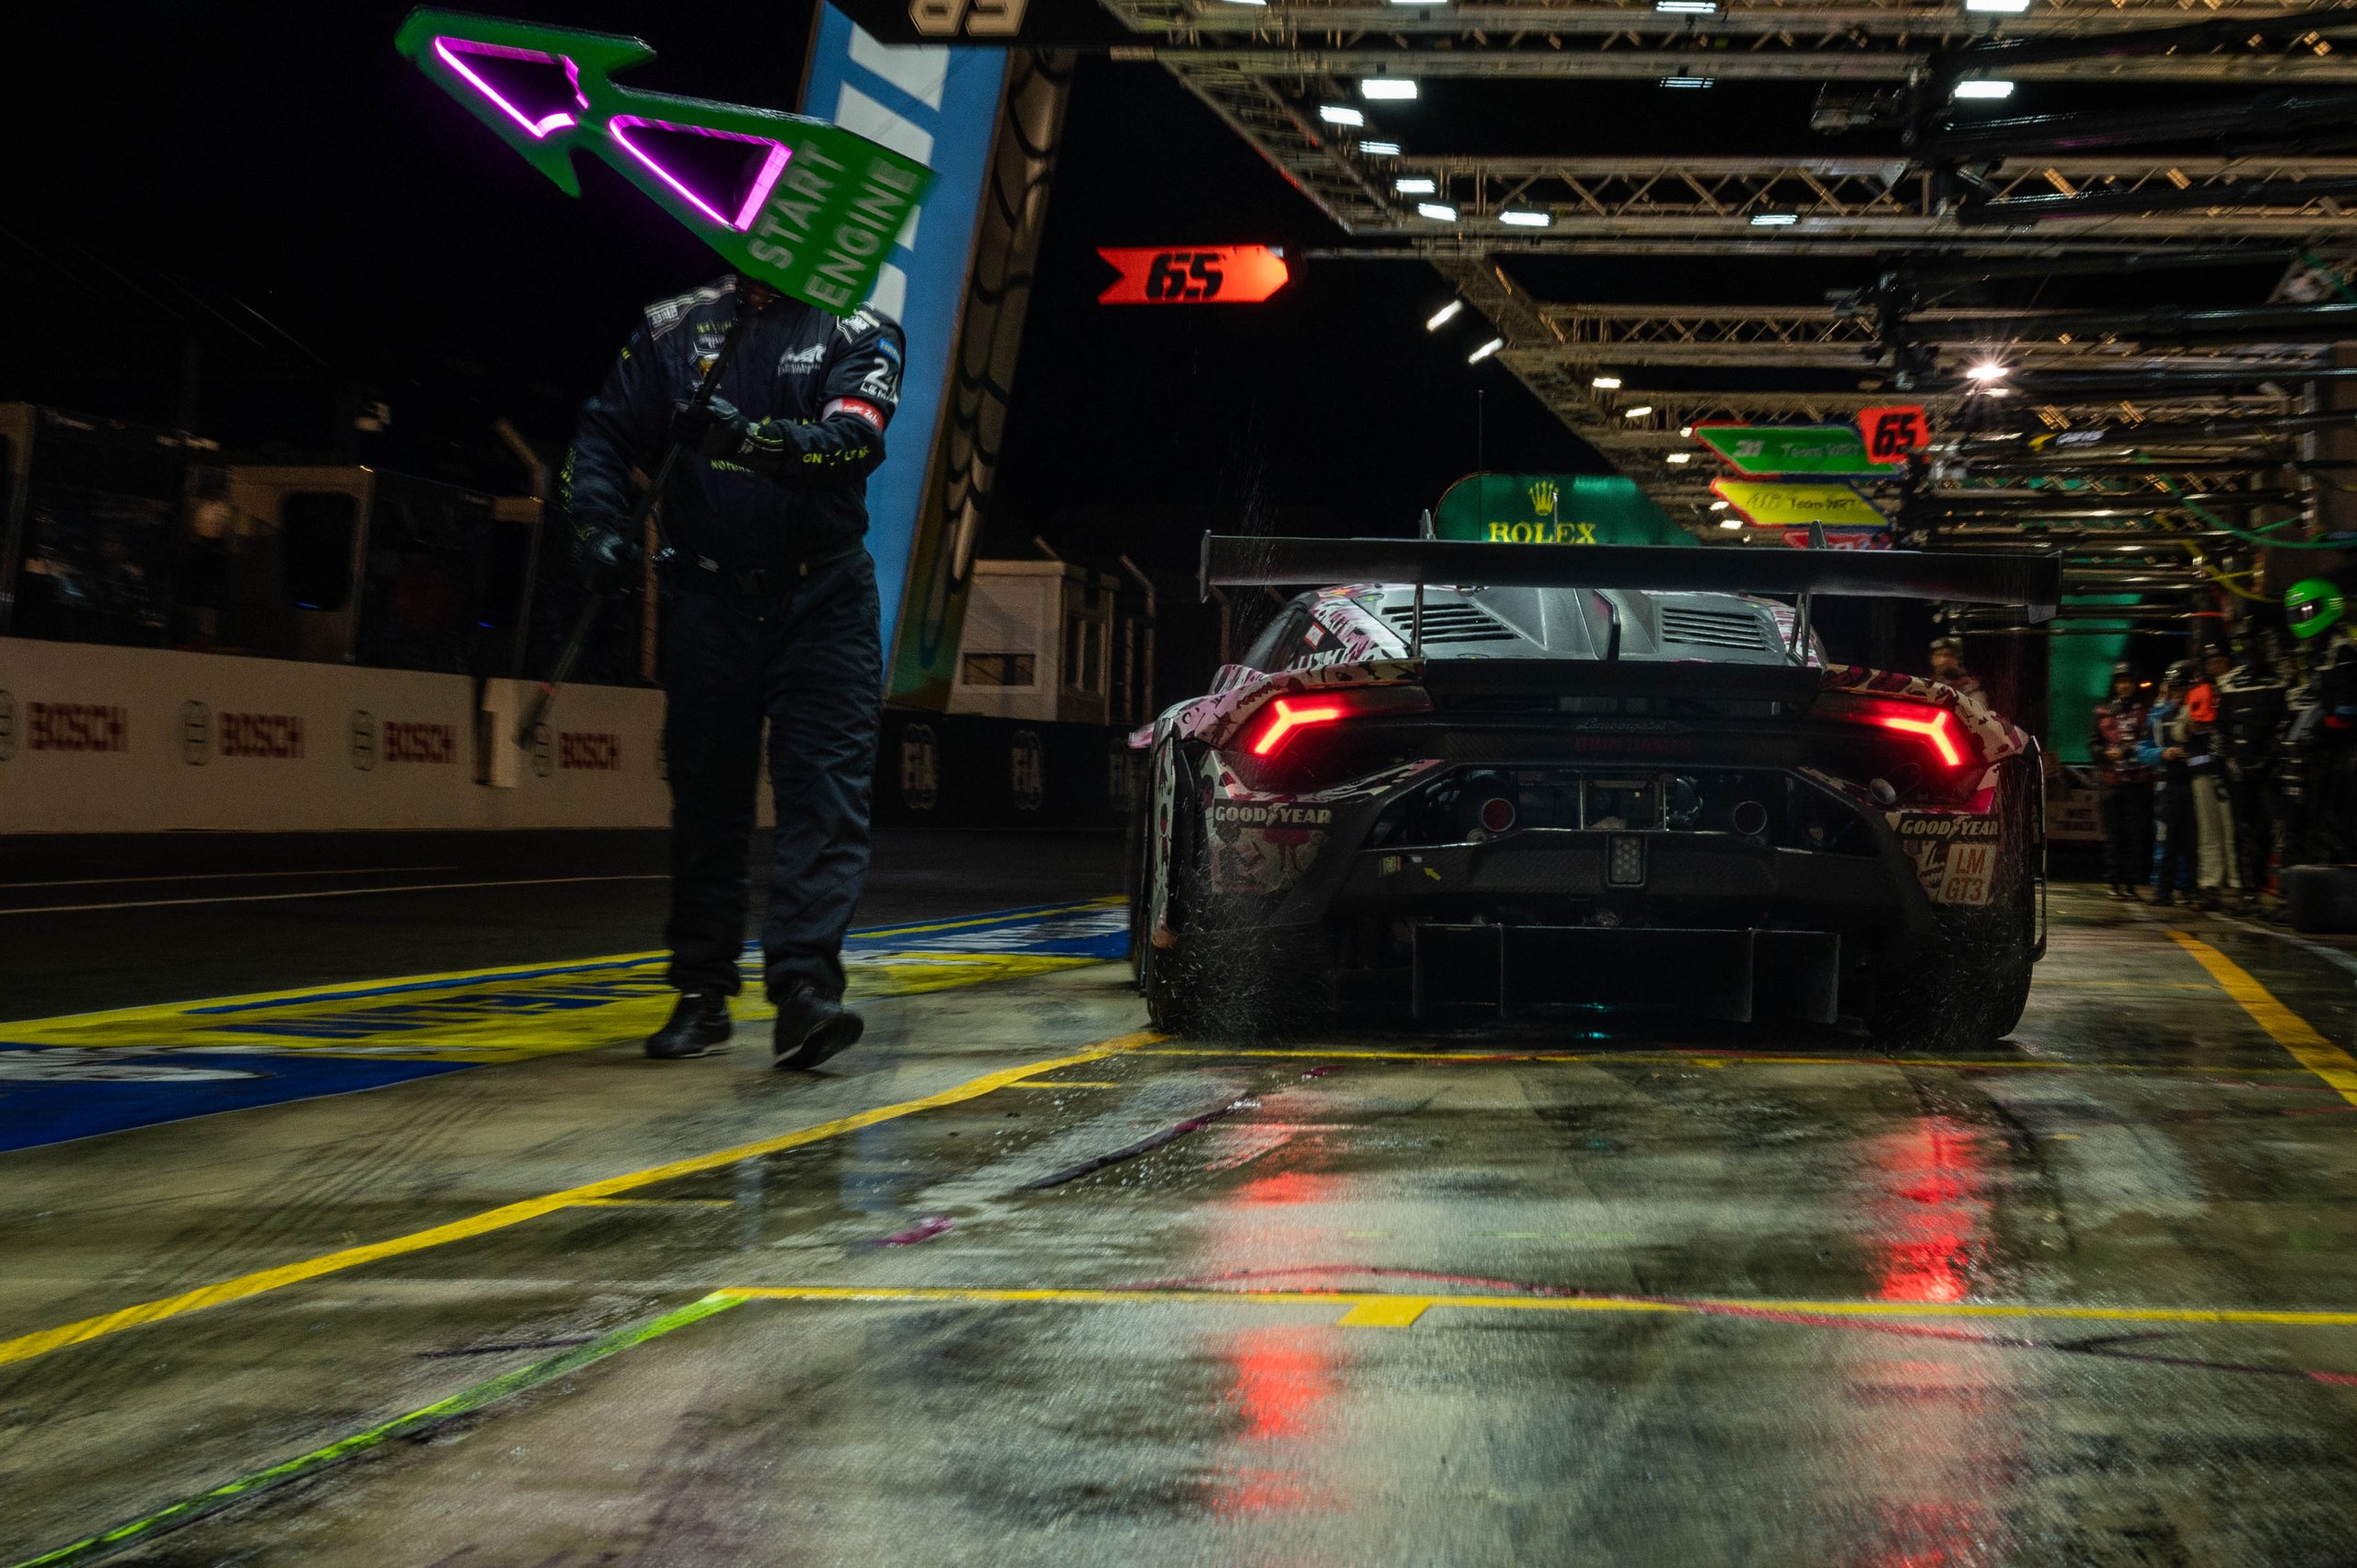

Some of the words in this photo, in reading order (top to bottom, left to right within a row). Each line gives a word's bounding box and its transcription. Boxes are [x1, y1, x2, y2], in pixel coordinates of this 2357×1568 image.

[748, 139, 846, 270] START
[802, 156, 922, 308] ENGINE
[1145, 253, 1224, 297] 65
[1873, 413, 1917, 456] 65
[1488, 520, 1597, 544] ROLEX
[27, 702, 128, 751] BOSCH
[219, 712, 305, 758] BOSCH
[382, 722, 457, 764] BOSCH
[558, 732, 621, 771] BOSCH
[1214, 803, 1333, 825] GOODYEAR
[1900, 816, 1999, 838] GOODYEAR
[1956, 849, 1987, 874] LM
[1945, 877, 1984, 900] GT3
